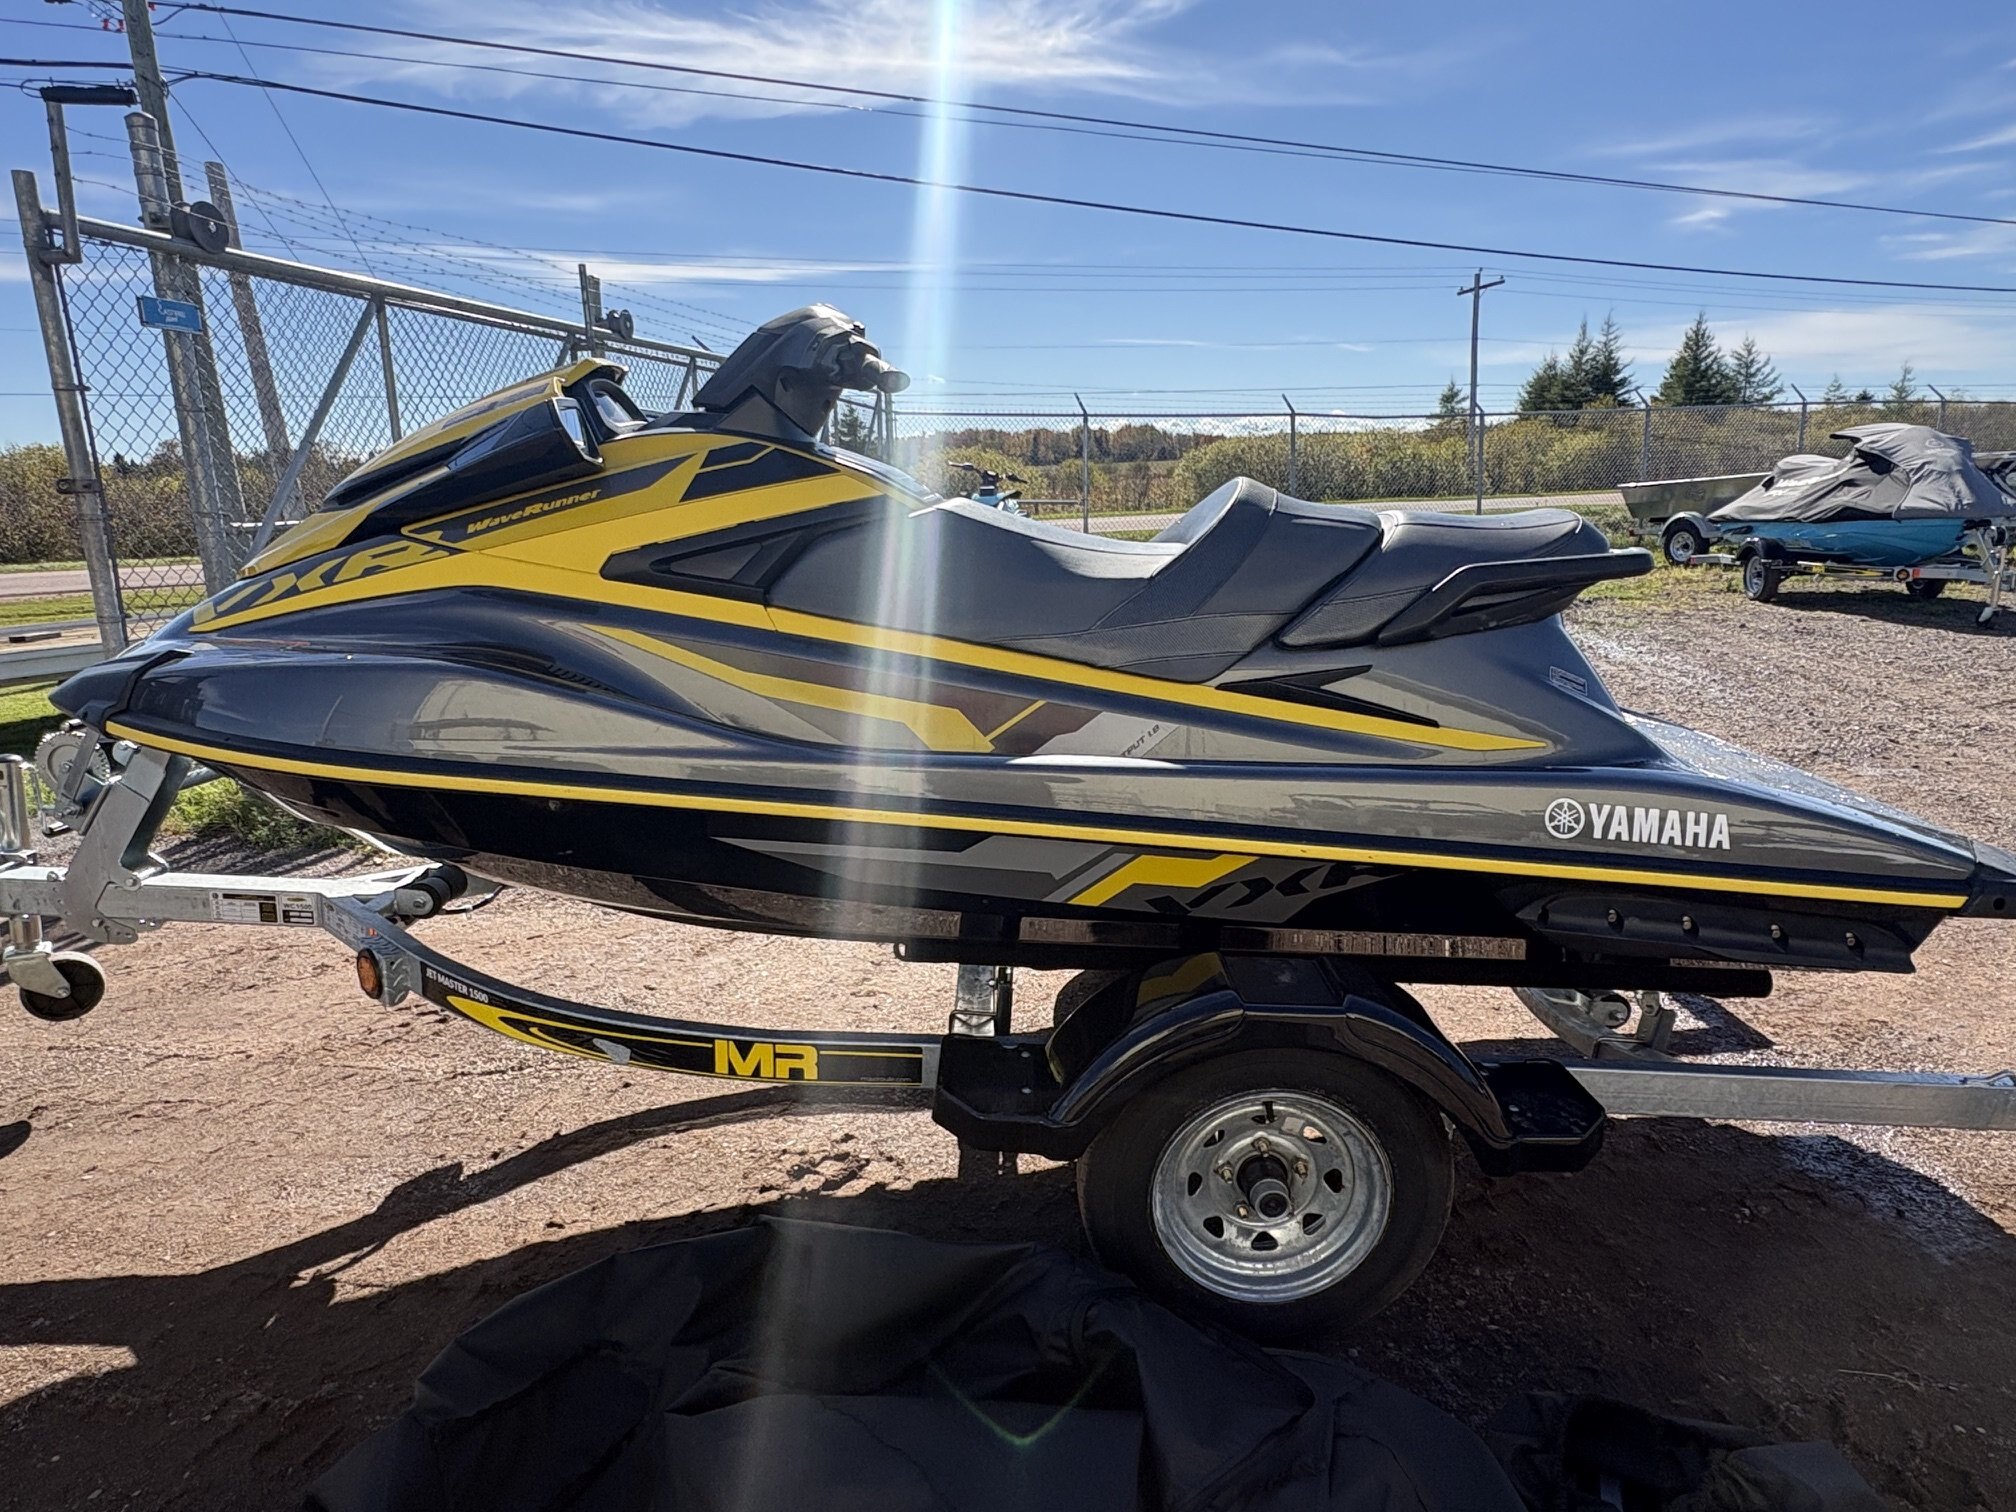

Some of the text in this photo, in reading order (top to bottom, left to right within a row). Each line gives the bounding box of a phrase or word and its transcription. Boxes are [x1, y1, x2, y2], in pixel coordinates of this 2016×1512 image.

[466, 489, 602, 534] WaveRunner
[1588, 802, 1732, 850] YAMAHA
[425, 967, 489, 1004] JET MASTER 1500
[713, 1038, 820, 1081] MR
